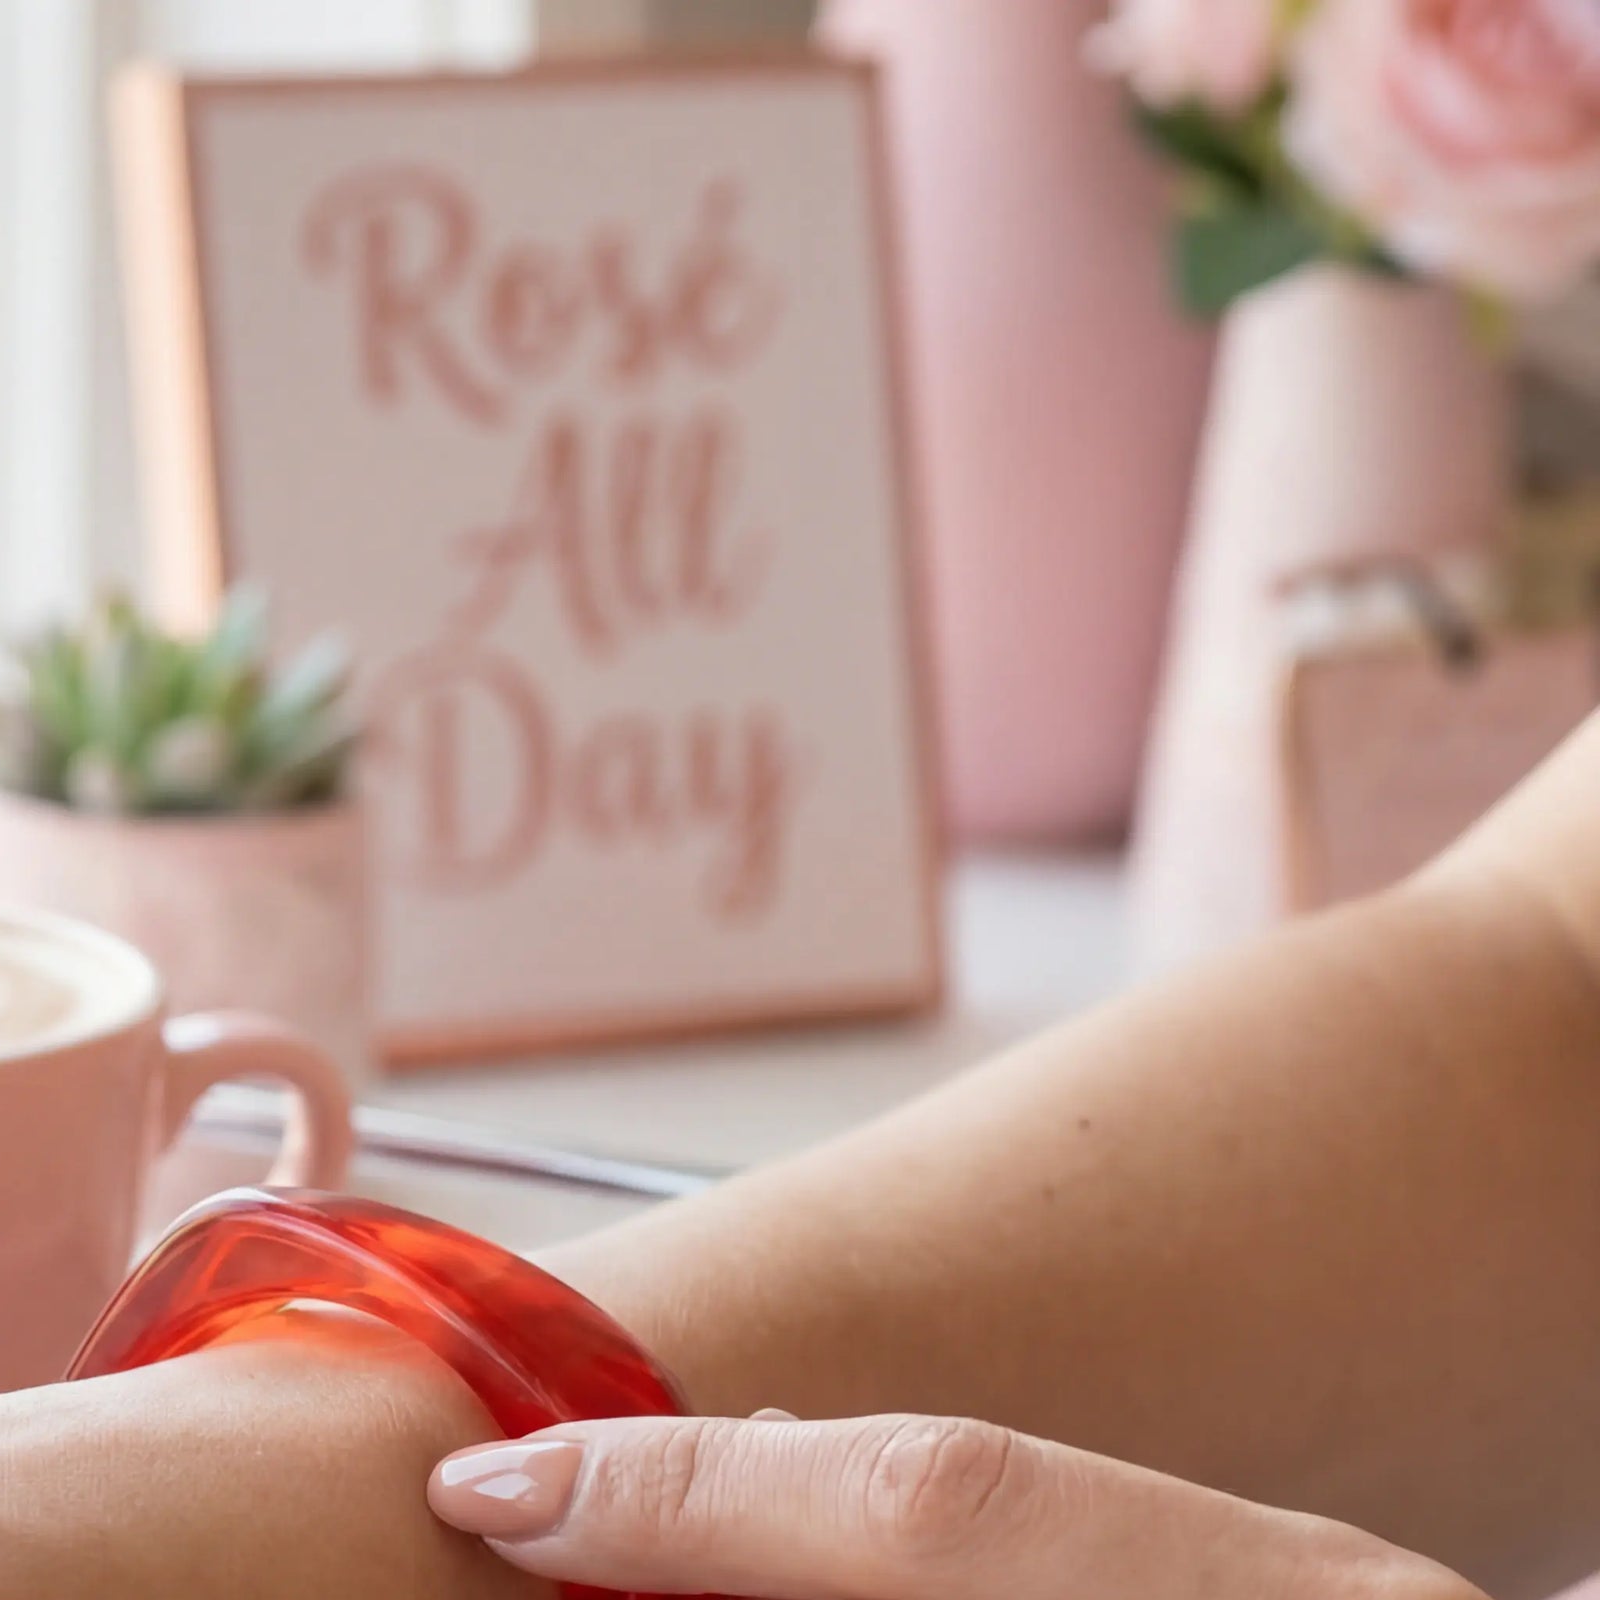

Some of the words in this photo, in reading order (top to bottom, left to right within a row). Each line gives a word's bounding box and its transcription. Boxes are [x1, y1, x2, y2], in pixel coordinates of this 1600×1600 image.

[302, 162, 782, 426] Rosé
[448, 408, 772, 658] All
[368, 642, 792, 924] Day
